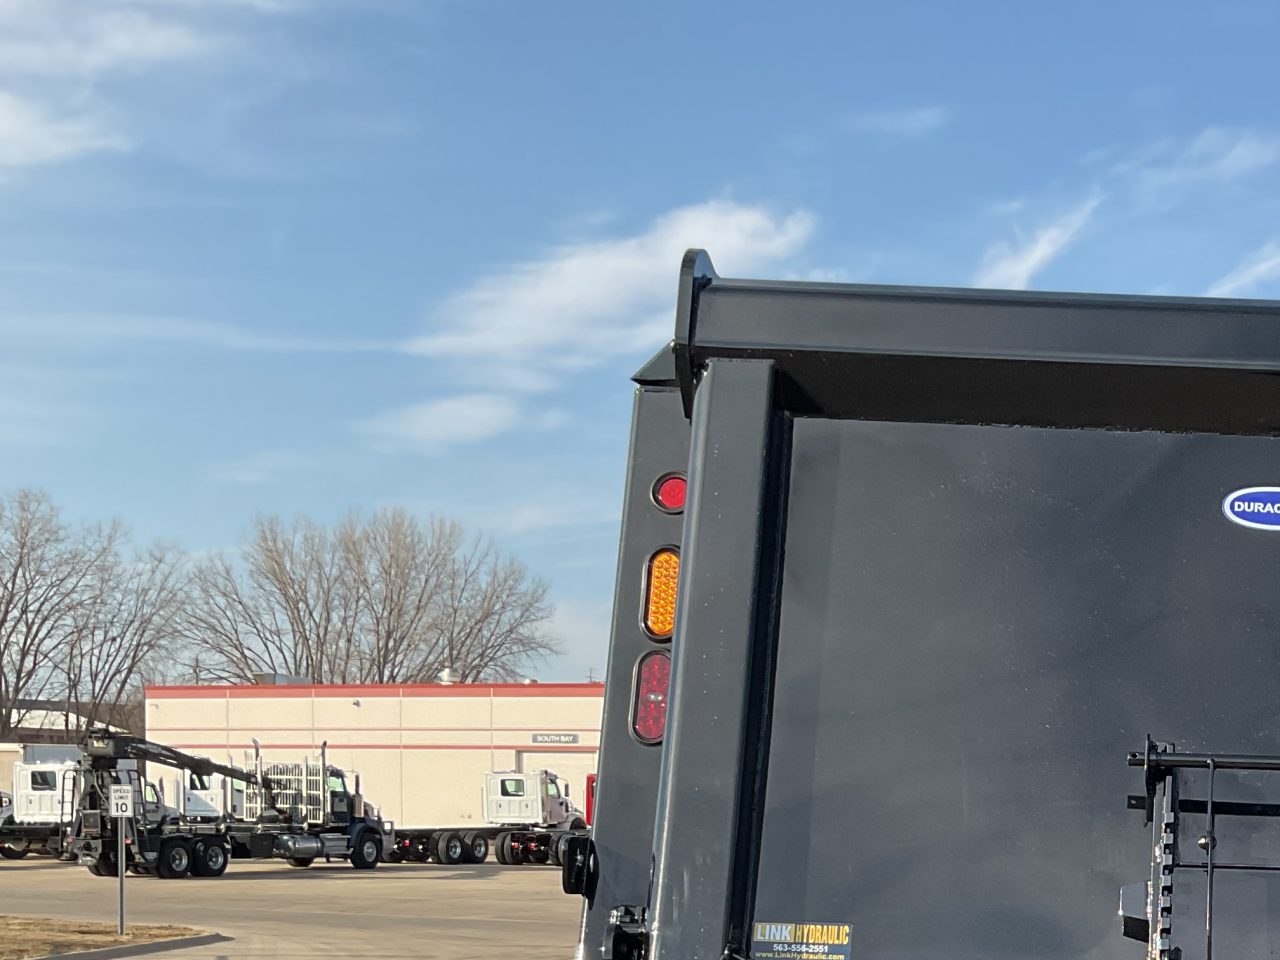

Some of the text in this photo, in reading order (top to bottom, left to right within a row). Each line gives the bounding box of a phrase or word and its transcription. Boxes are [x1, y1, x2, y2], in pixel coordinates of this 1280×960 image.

[536, 735, 574, 743] SOUTH BAY
[115, 802, 128, 813] 10
[756, 924, 849, 945] LINK HYDRAULIC
